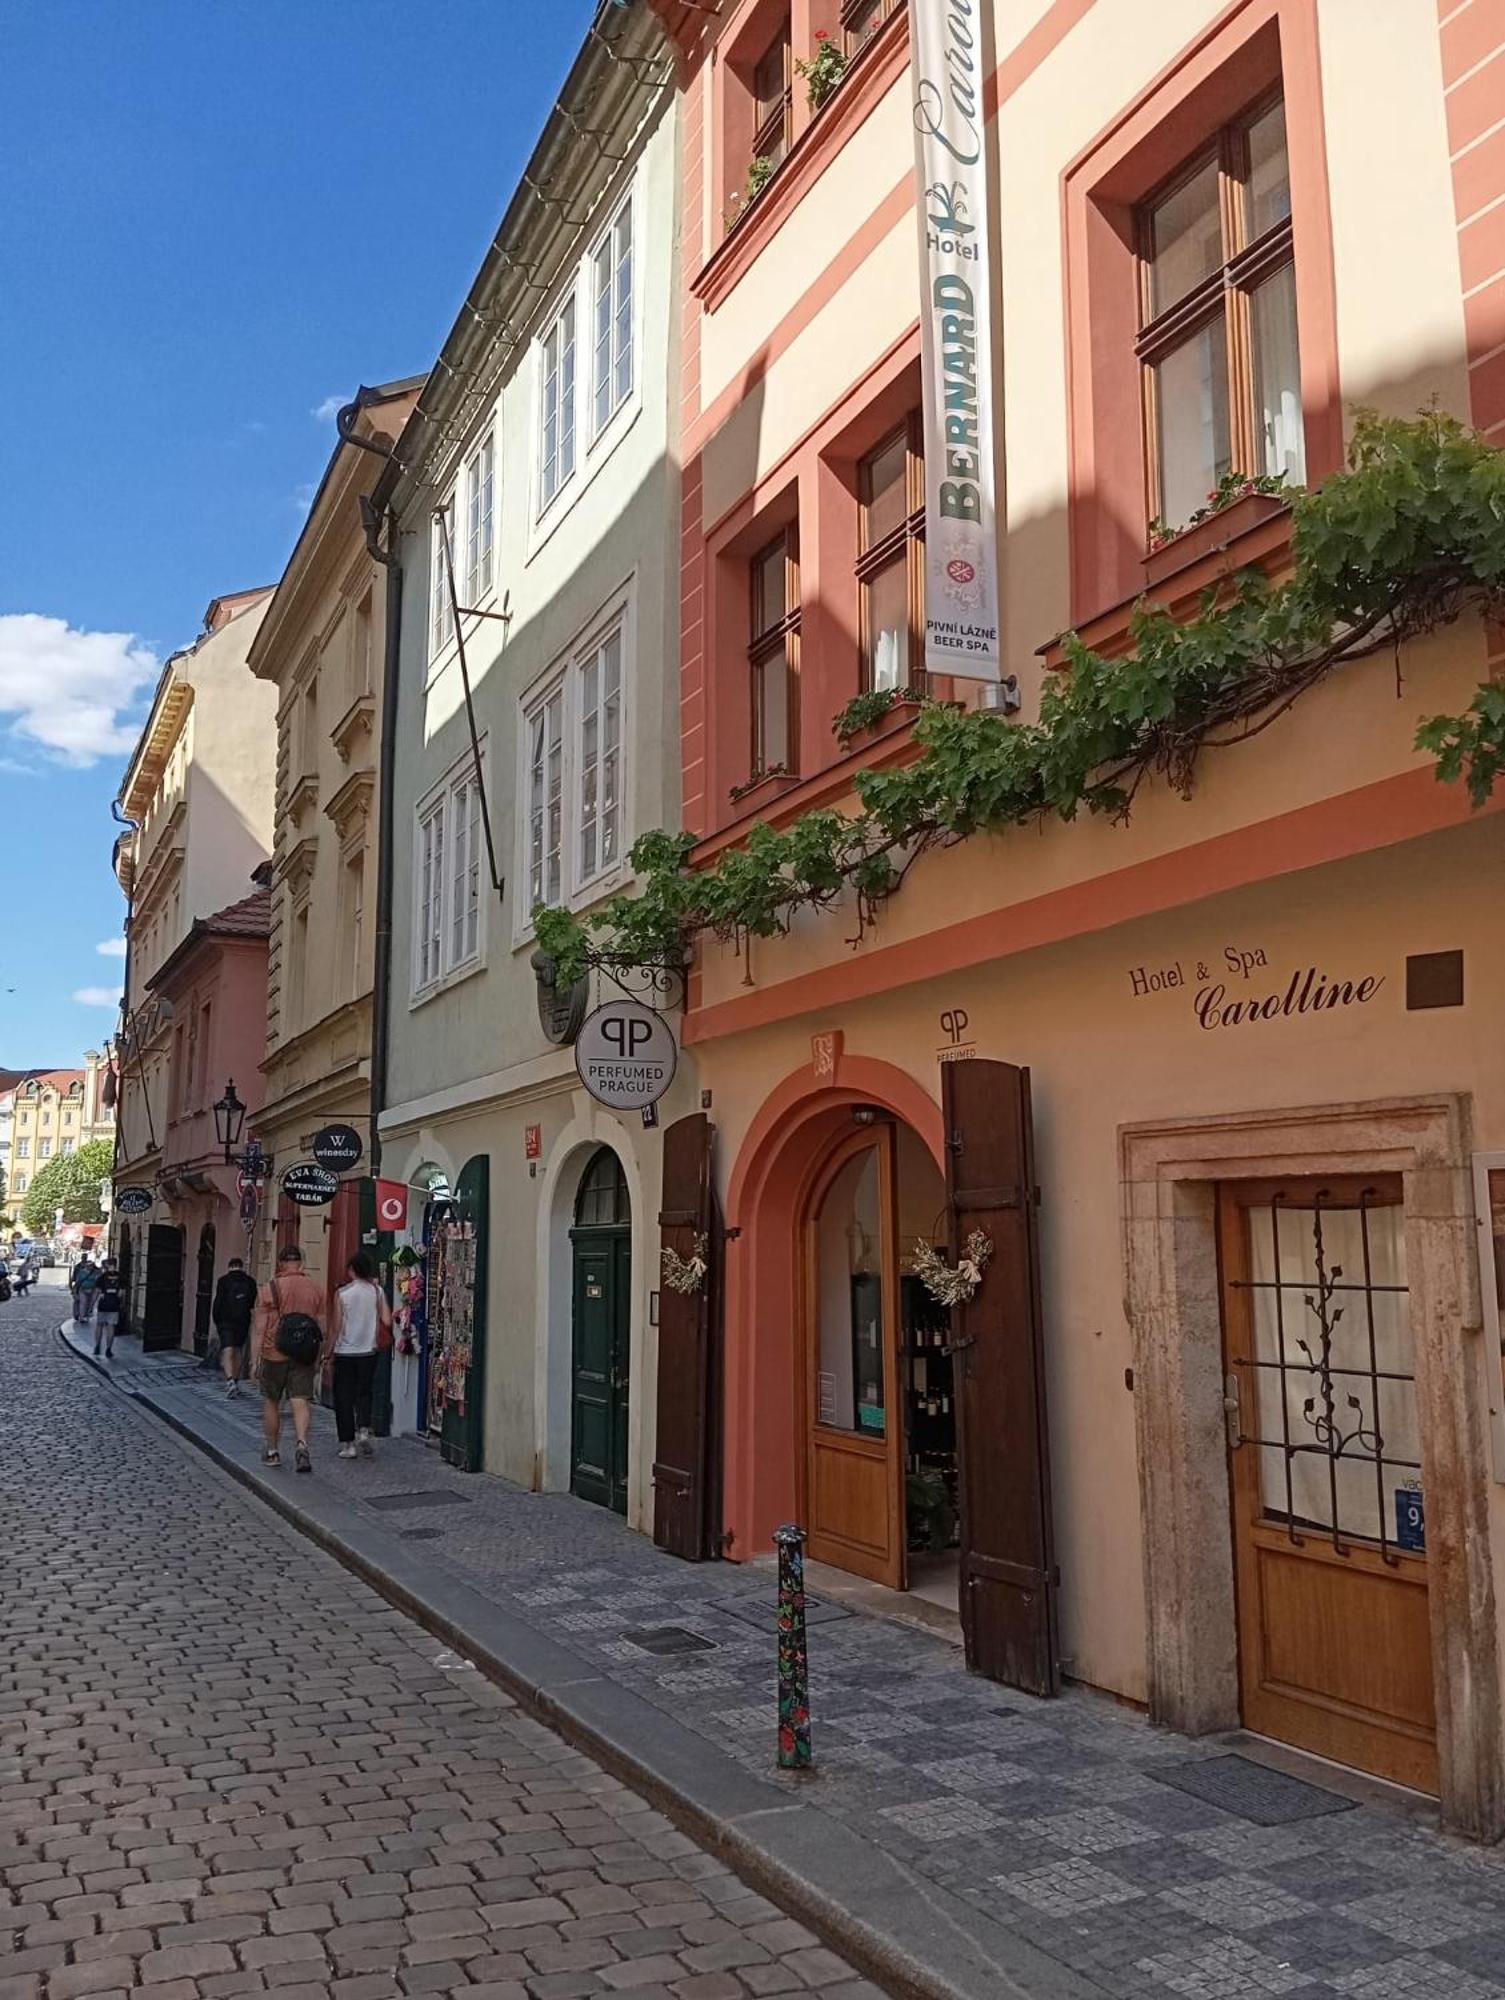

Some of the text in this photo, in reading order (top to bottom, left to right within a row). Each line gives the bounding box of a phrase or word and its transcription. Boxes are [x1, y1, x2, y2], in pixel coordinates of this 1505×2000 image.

[926, 232, 979, 261] Hotel
[933, 273, 981, 525] BERNARD
[927, 620, 958, 634] PIVNÍ
[934, 635, 989, 652] BEER SPA
[1128, 946, 1268, 998] Hotel & Spa
[1194, 967, 1386, 1031] Carolline
[589, 1065, 664, 1080] PERFUMED
[599, 1080, 654, 1093] PRAGUE
[330, 1135, 345, 1147] W
[316, 1148, 358, 1159] winesday
[289, 1167, 337, 1184] EVA SHOP
